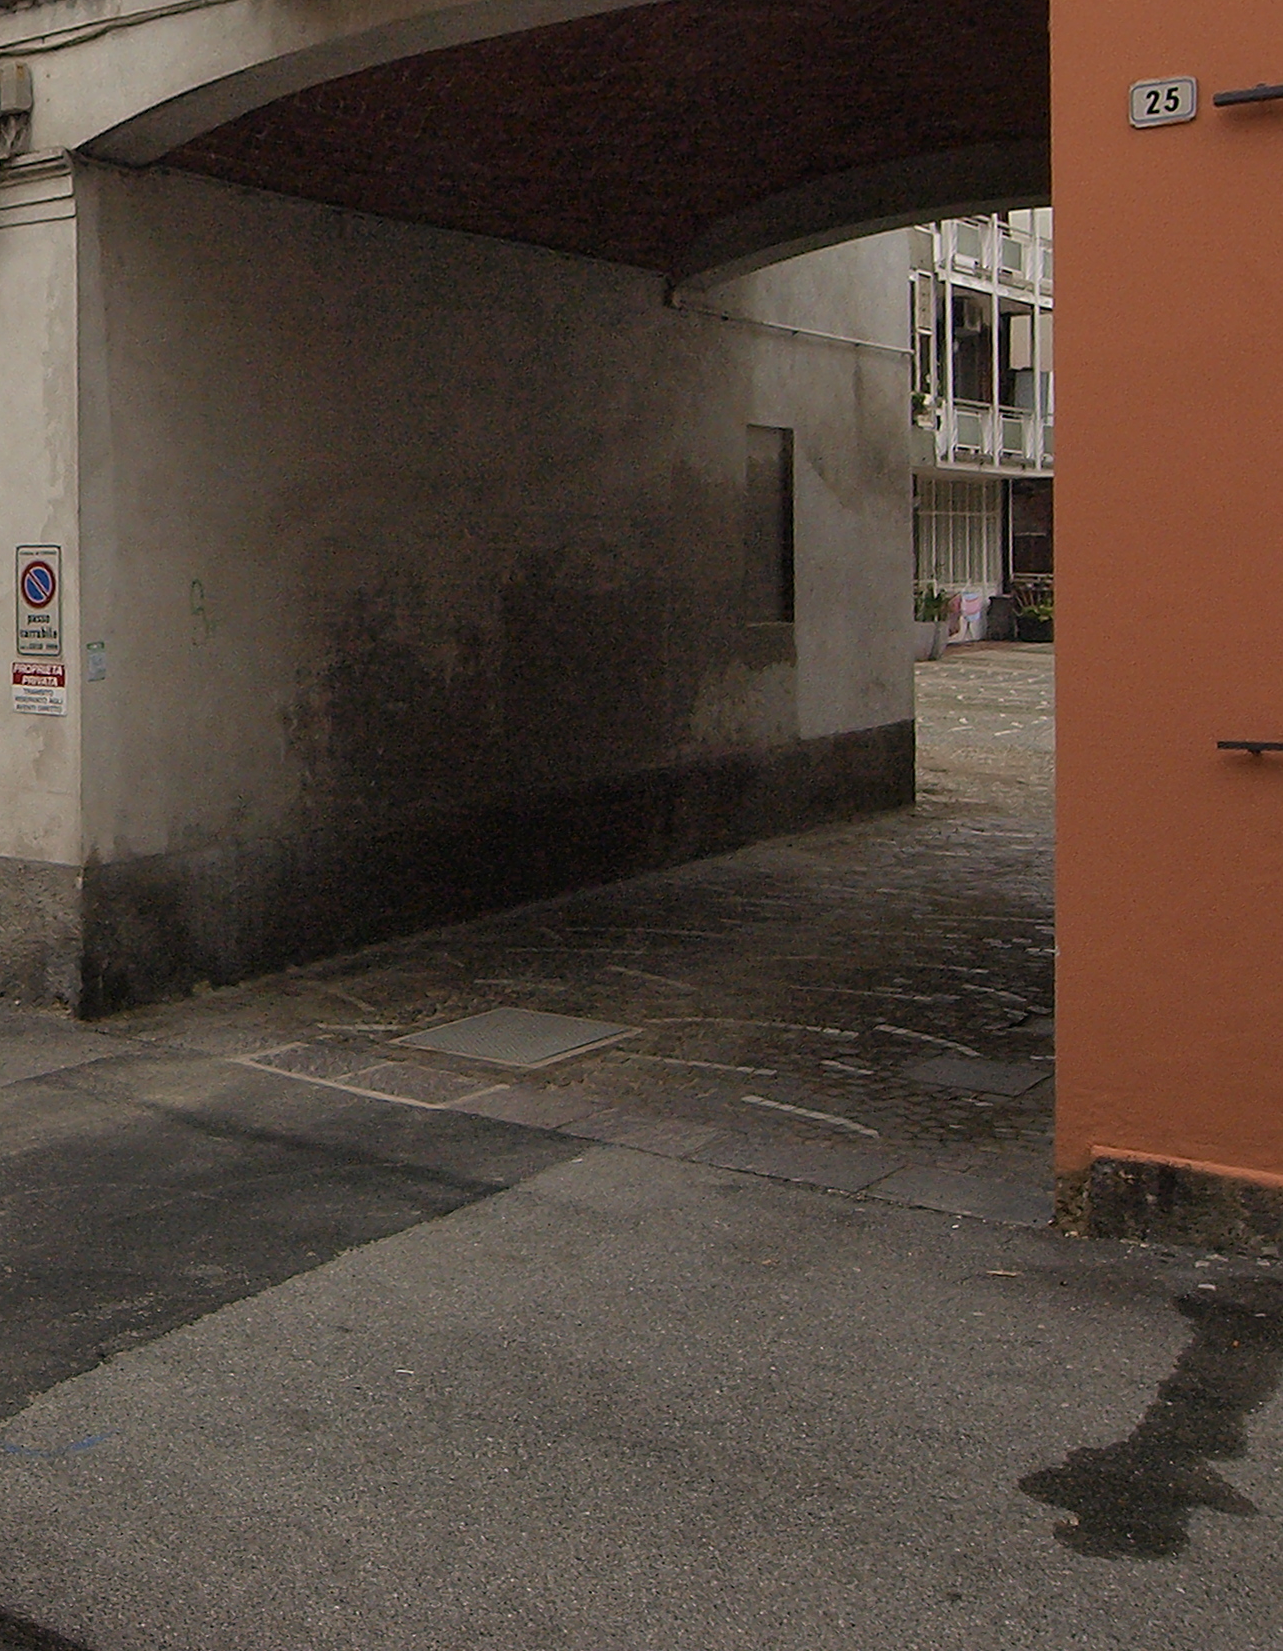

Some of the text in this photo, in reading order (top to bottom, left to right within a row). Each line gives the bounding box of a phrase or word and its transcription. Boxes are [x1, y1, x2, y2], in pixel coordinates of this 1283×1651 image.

[1145, 86, 1180, 115] 25
[27, 614, 50, 625] passo
[20, 626, 58, 639] carrabile
[22, 675, 58, 687] PRIVATA
